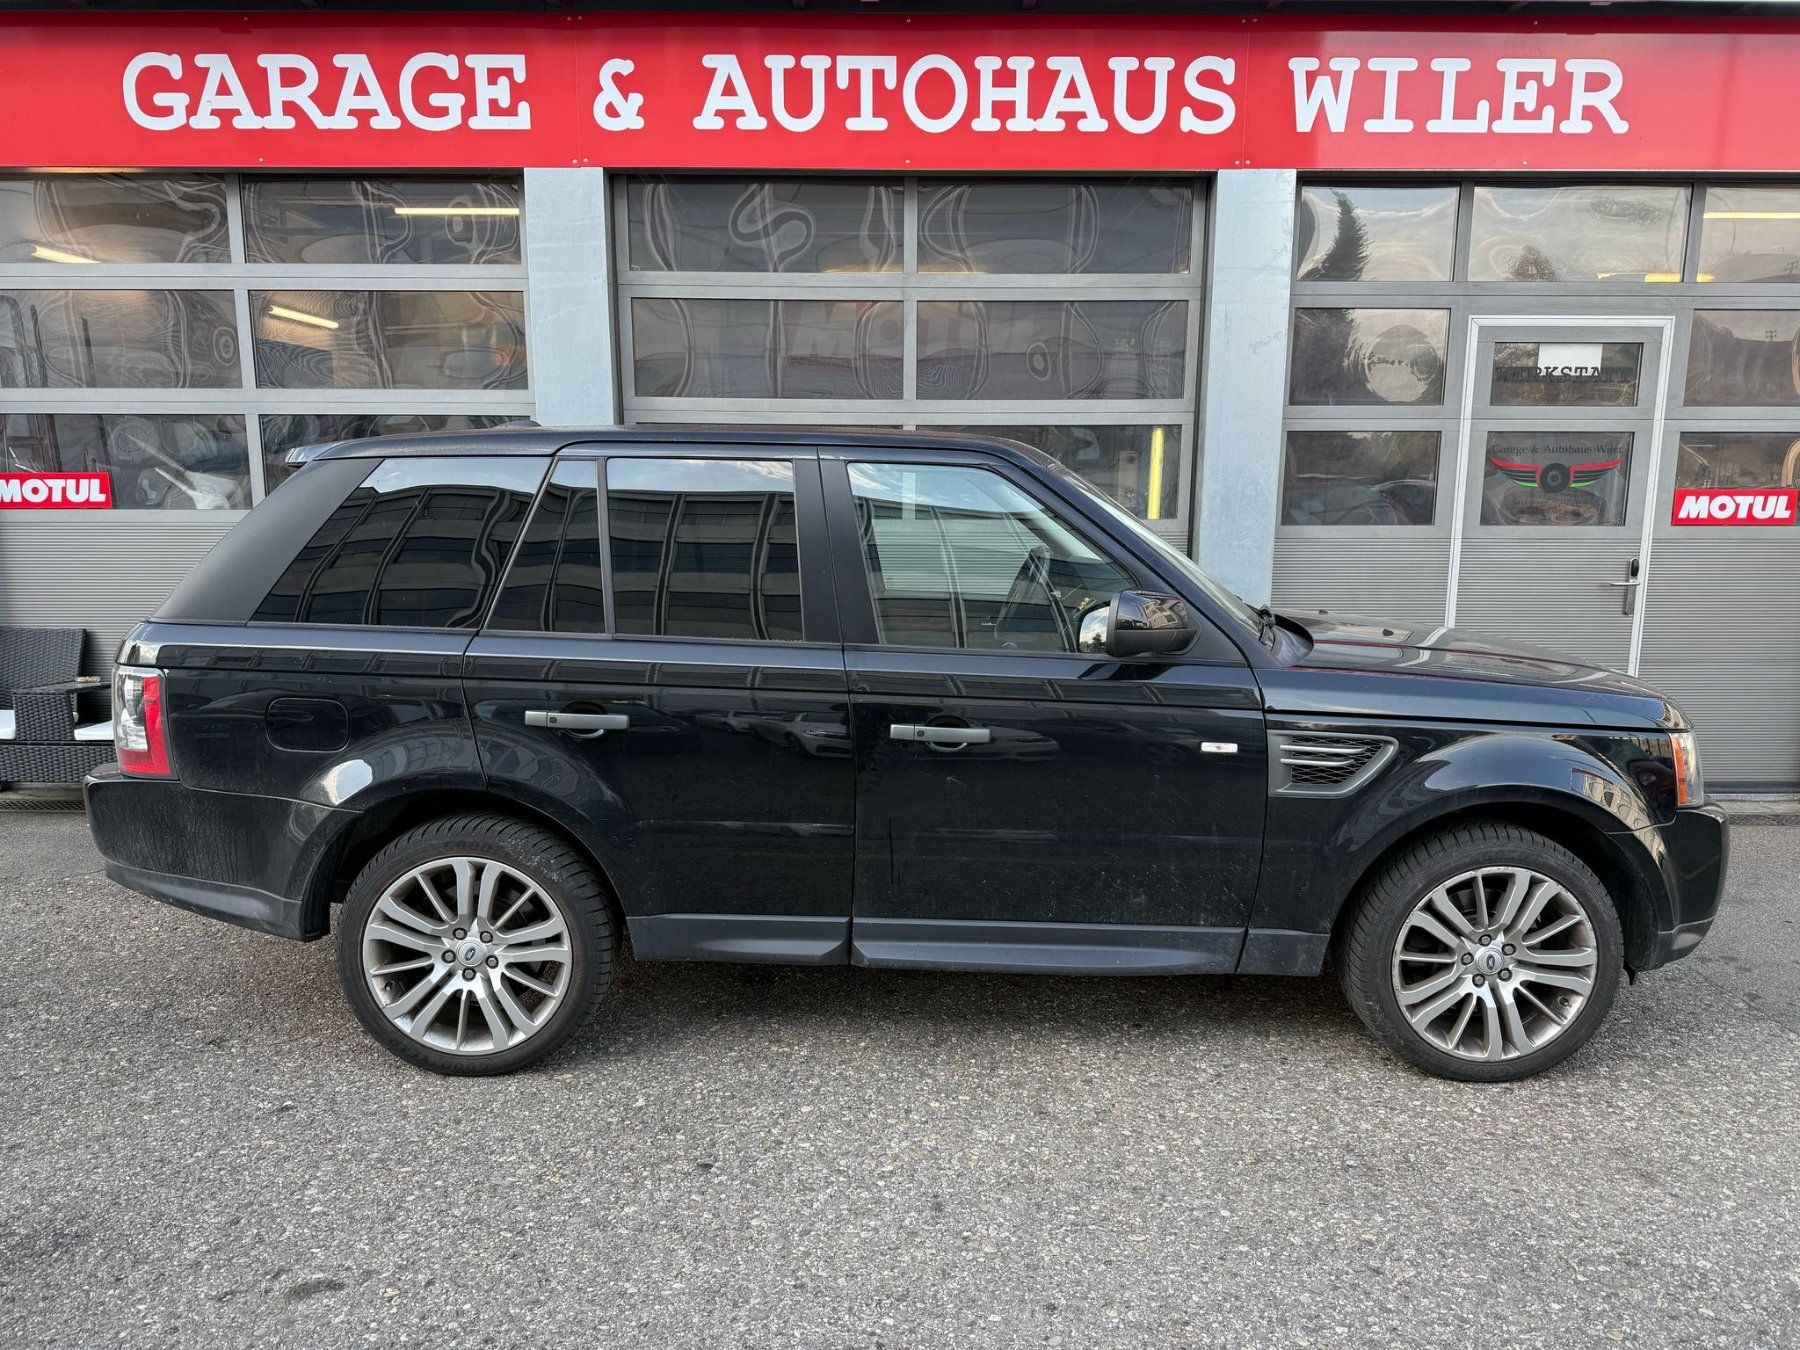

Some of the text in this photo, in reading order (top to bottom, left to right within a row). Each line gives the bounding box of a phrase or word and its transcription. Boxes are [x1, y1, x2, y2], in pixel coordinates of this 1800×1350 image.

[122, 51, 1630, 135] GARAGE & AUTOHAUS WILER
[0, 478, 106, 503] MOTUL
[1677, 495, 1792, 519] MOTUL
